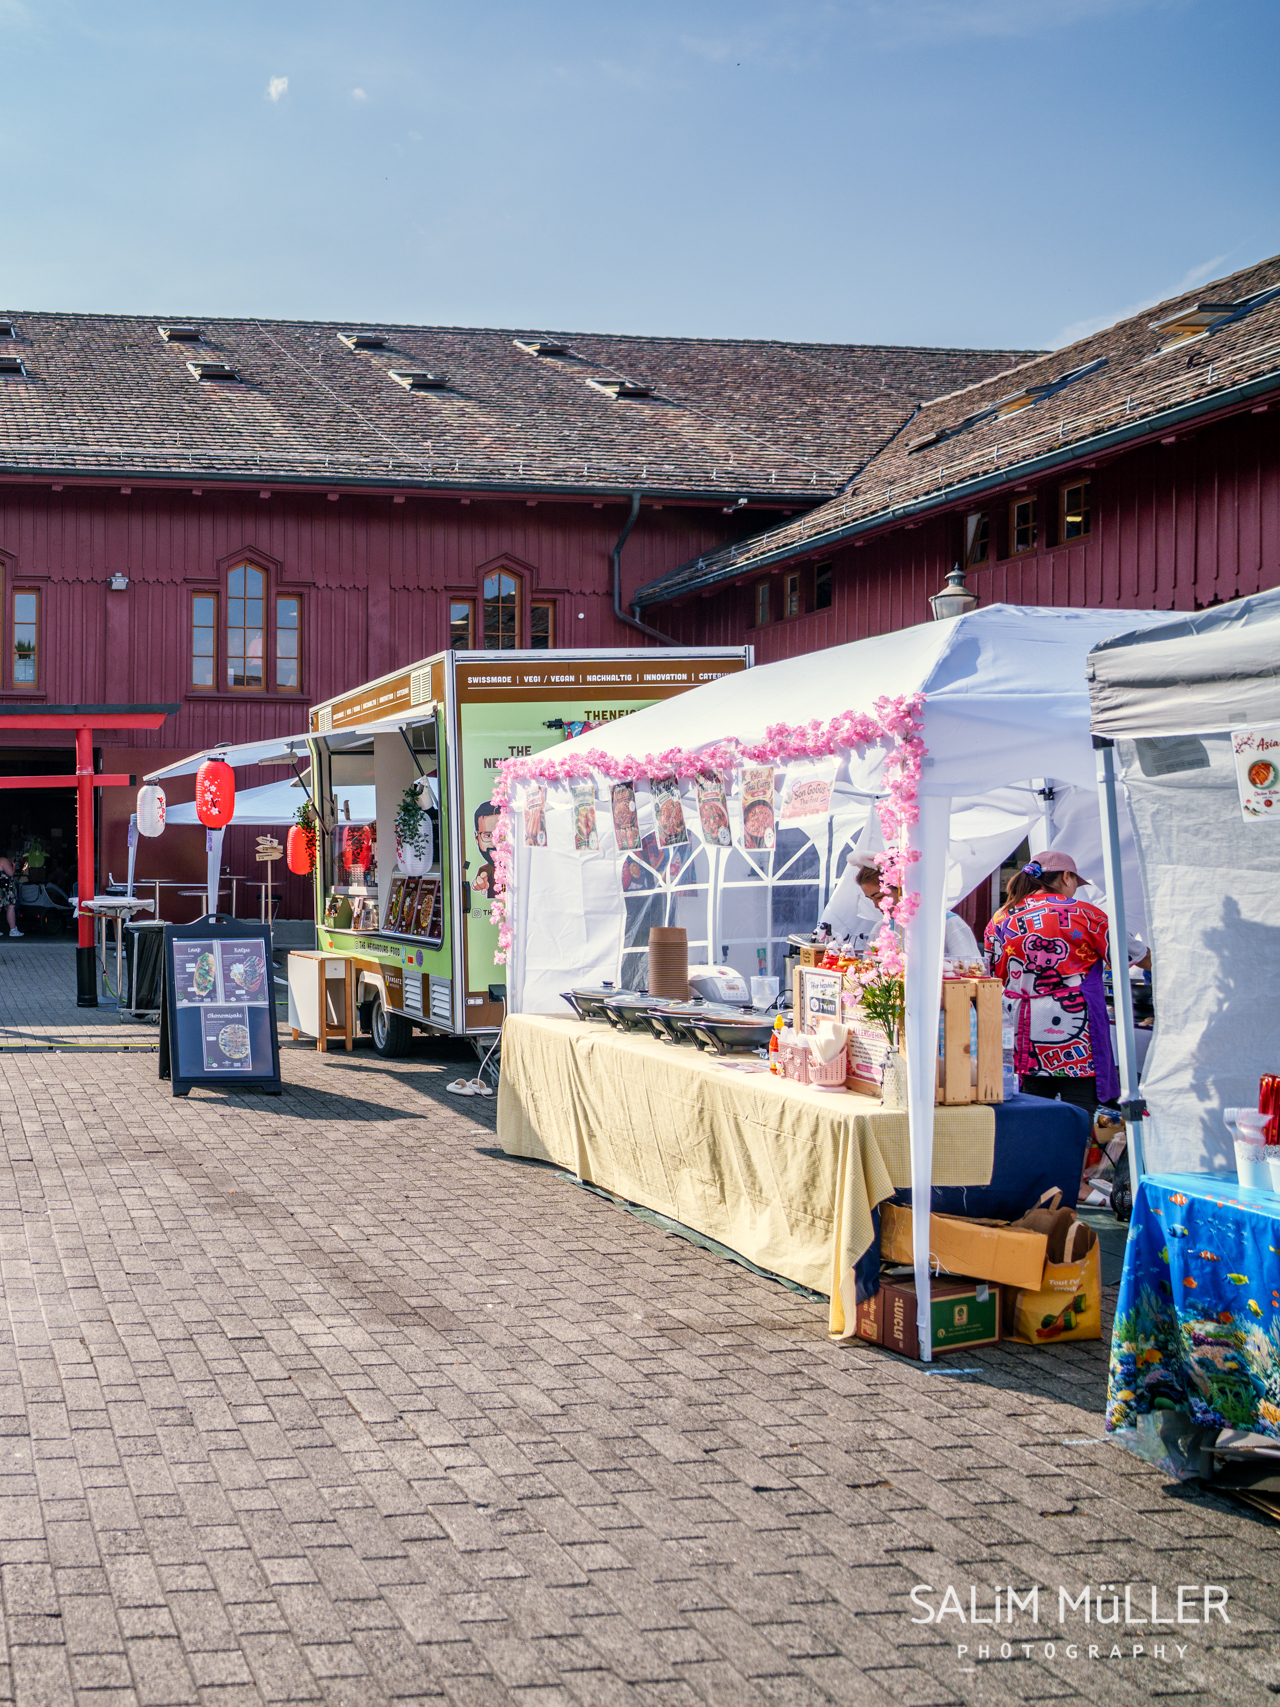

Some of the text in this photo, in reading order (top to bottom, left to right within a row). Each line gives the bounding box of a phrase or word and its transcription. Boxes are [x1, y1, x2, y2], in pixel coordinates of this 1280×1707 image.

[467, 676, 512, 684] SWISSMADE
[523, 675, 541, 683] VEGI
[550, 675, 575, 683] VEGAN
[586, 674, 632, 682] NACHHALTIG
[643, 673, 687, 681] INNOVATION
[508, 745, 532, 757] THE
[744, 779, 771, 793] Thai Curry
[994, 907, 1108, 945] KITTY
